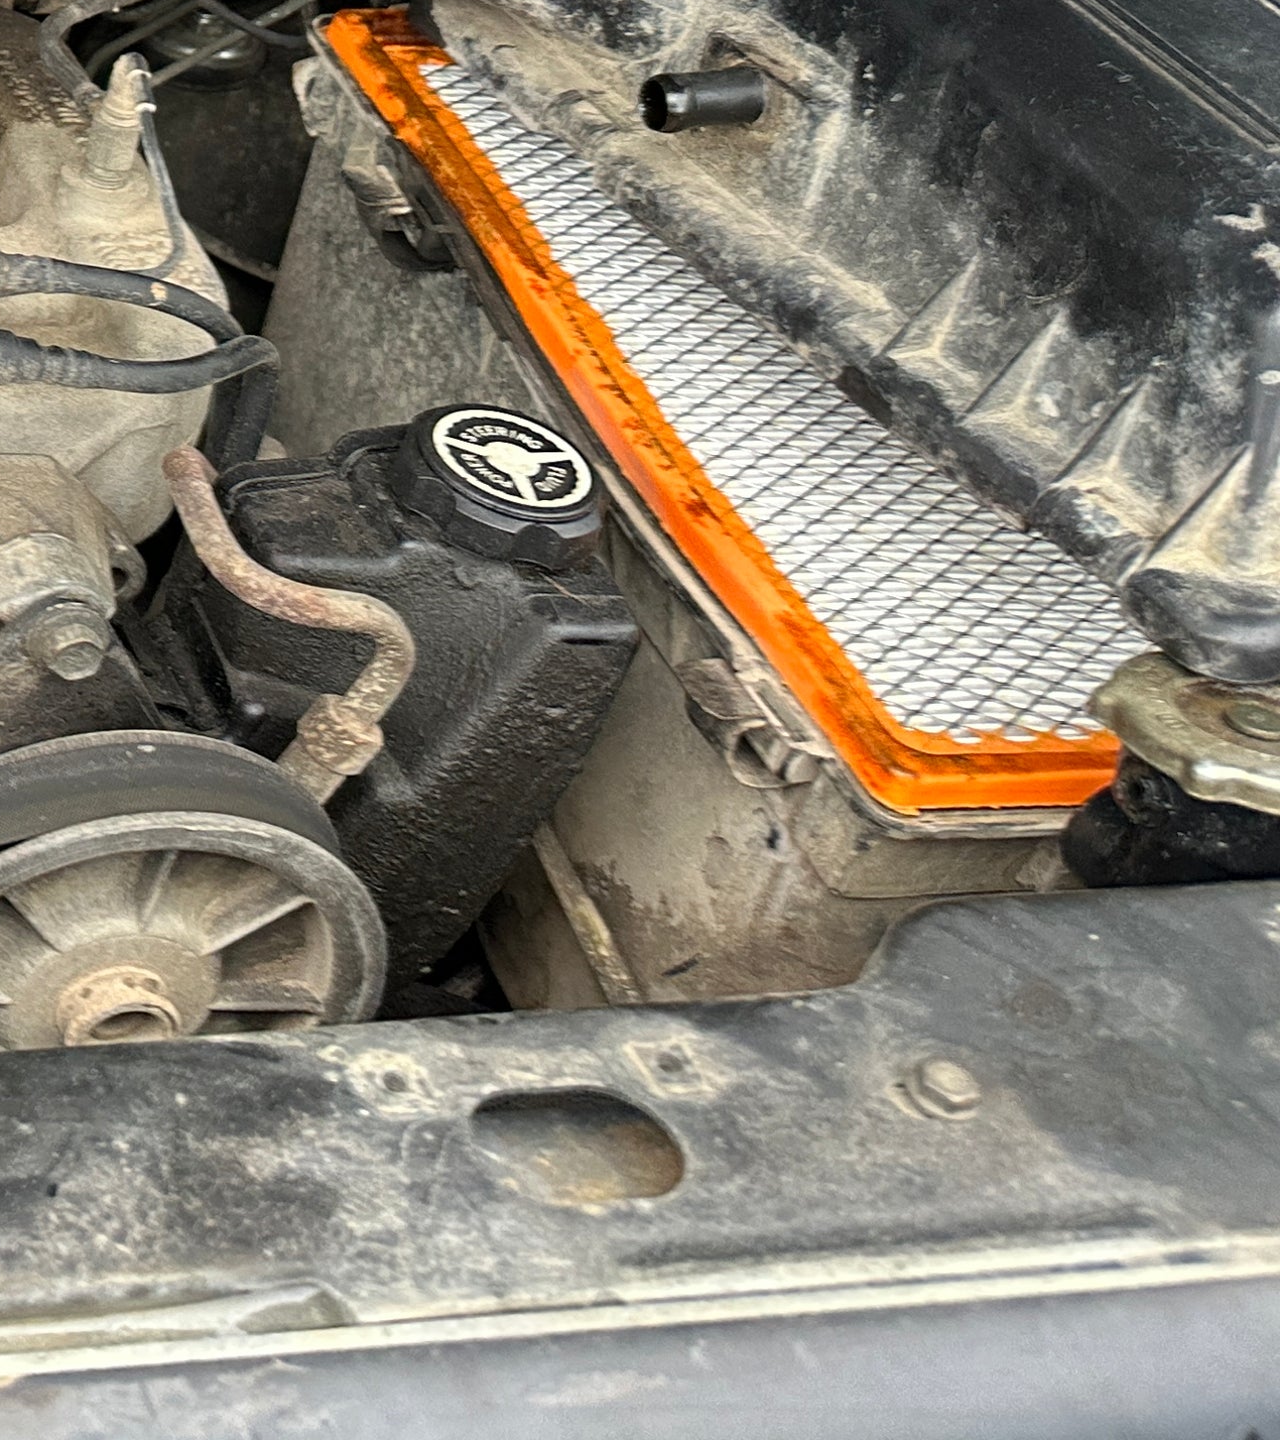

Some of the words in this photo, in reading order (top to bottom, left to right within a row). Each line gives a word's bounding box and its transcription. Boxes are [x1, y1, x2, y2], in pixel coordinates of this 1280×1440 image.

[458, 424, 544, 450] STEERING
[460, 453, 514, 489] POWER
[534, 465, 568, 493] FLUID
